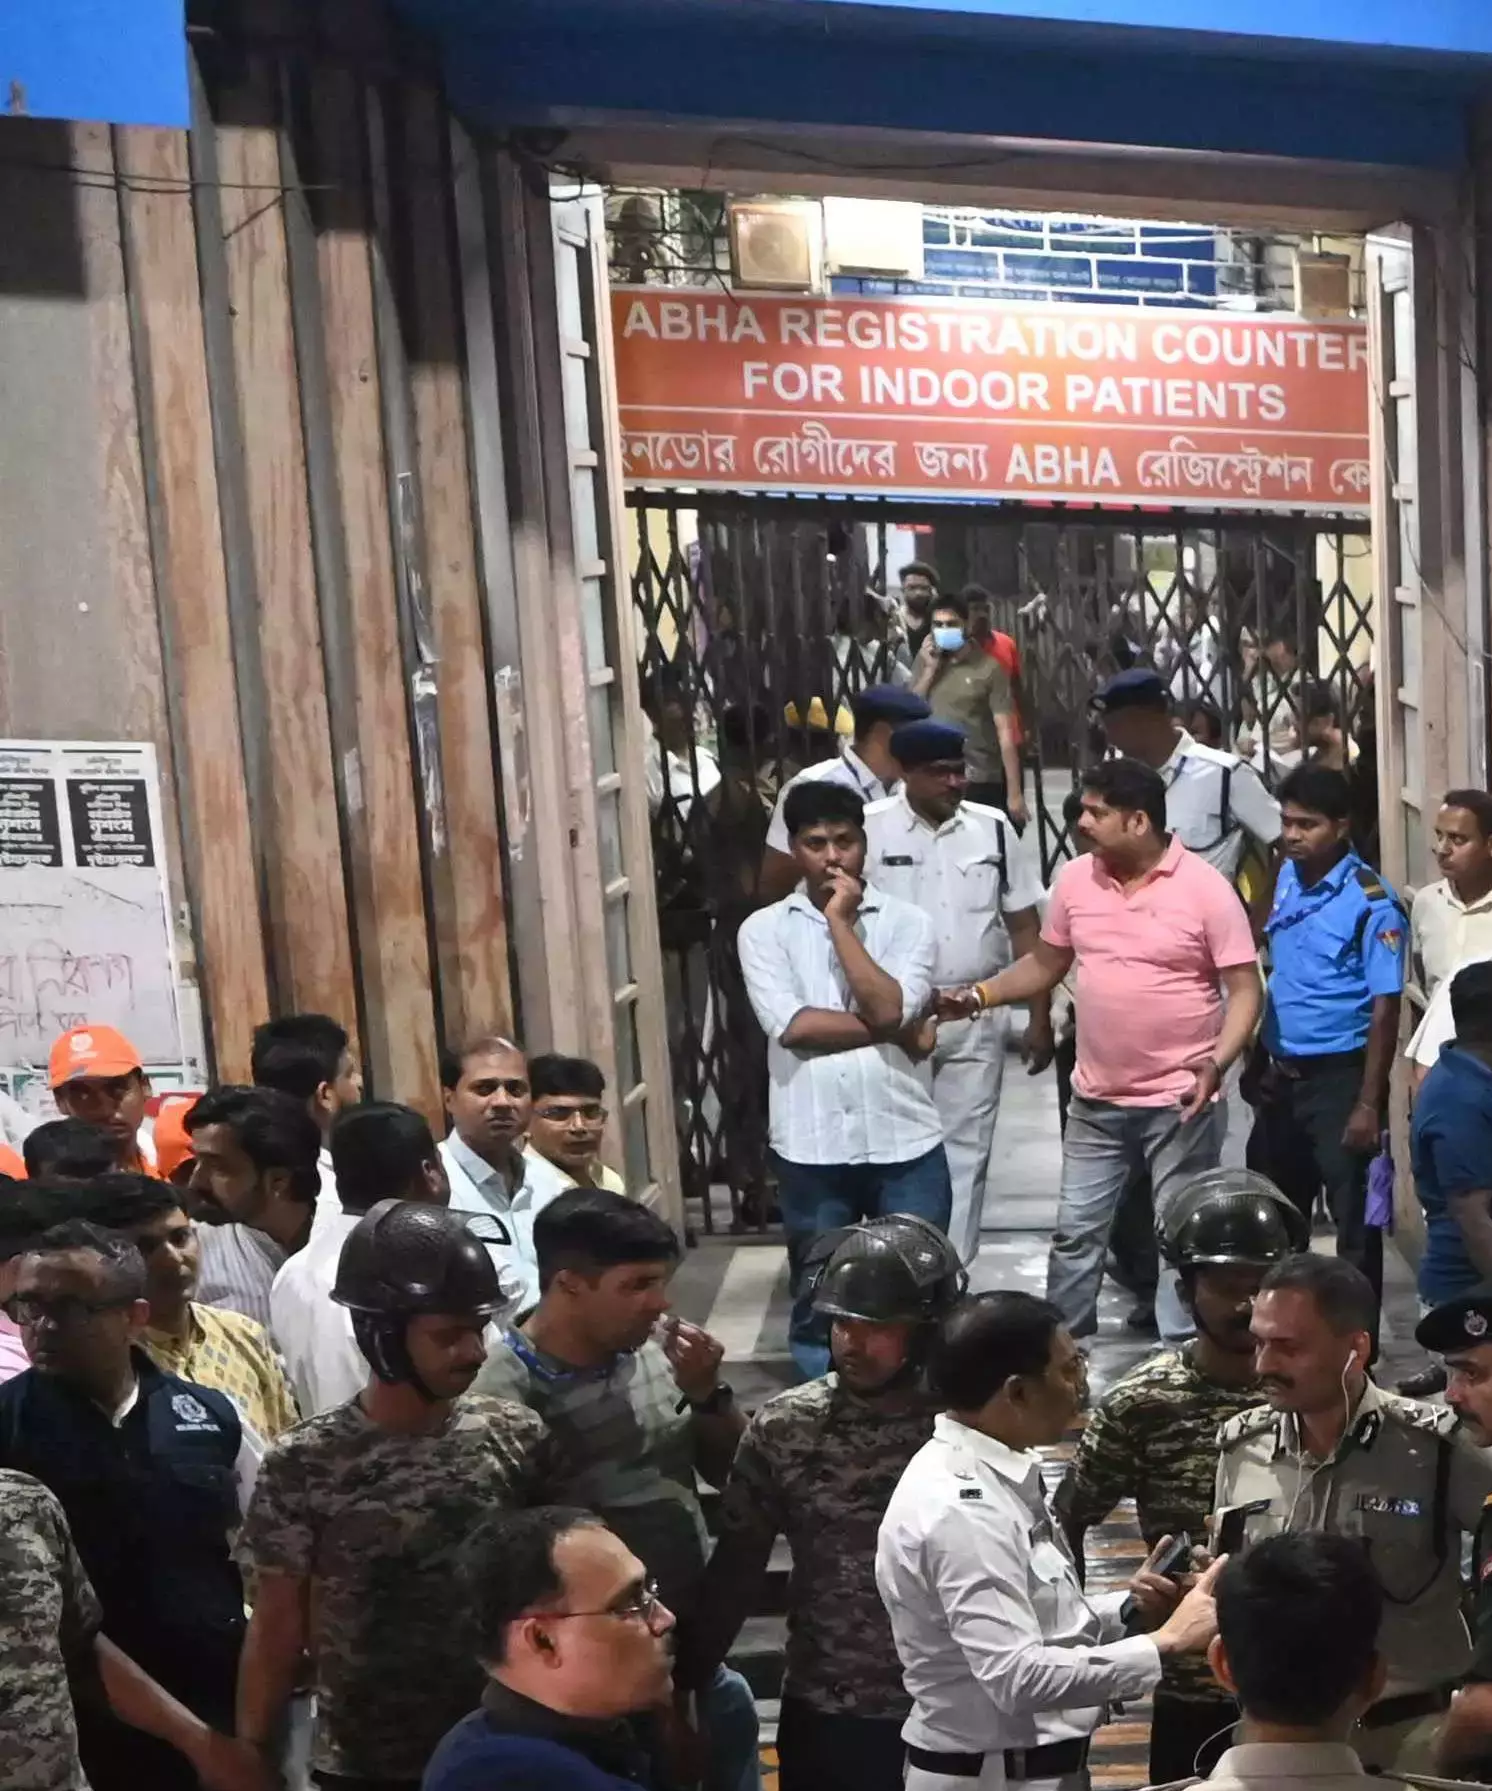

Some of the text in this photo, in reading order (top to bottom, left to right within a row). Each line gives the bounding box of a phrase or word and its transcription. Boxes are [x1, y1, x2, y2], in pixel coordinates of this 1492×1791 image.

[623, 300, 1369, 372] ABHA REGISTRATION COUNTER
[742, 361, 1287, 422] FOR INDOOR PATIENTS
[753, 420, 898, 478] রোগীদের
[913, 441, 988, 483] জন্য
[1005, 443, 1121, 487] ABHA
